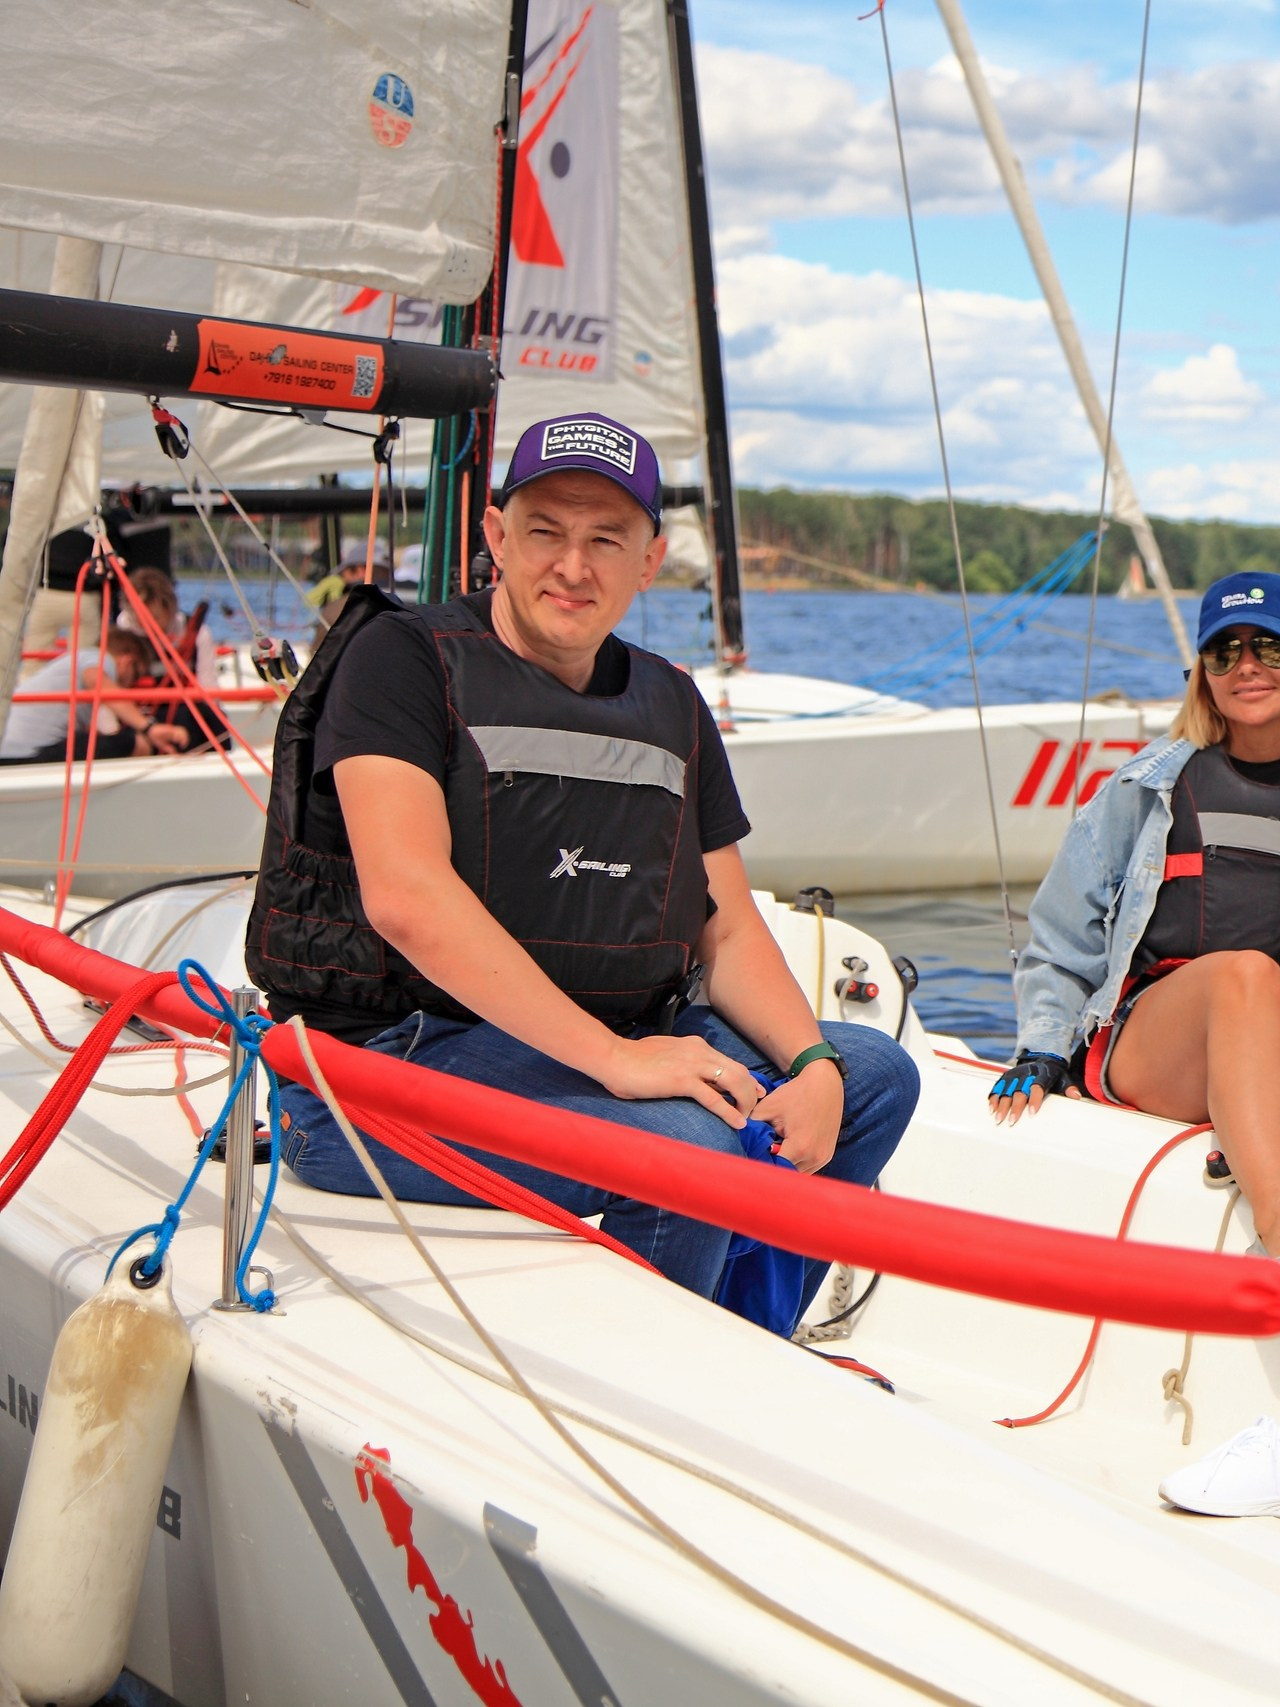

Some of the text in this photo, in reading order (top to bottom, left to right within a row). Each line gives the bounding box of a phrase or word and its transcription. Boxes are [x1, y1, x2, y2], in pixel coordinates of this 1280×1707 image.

[283, 356, 318, 370] SAILING
[320, 361, 354, 374] CENTER
[519, 347, 598, 373] CLUB
[547, 433, 631, 456] GAMES OF
[553, 424, 628, 446] PHYGITAL
[565, 442, 630, 467] FUTURE
